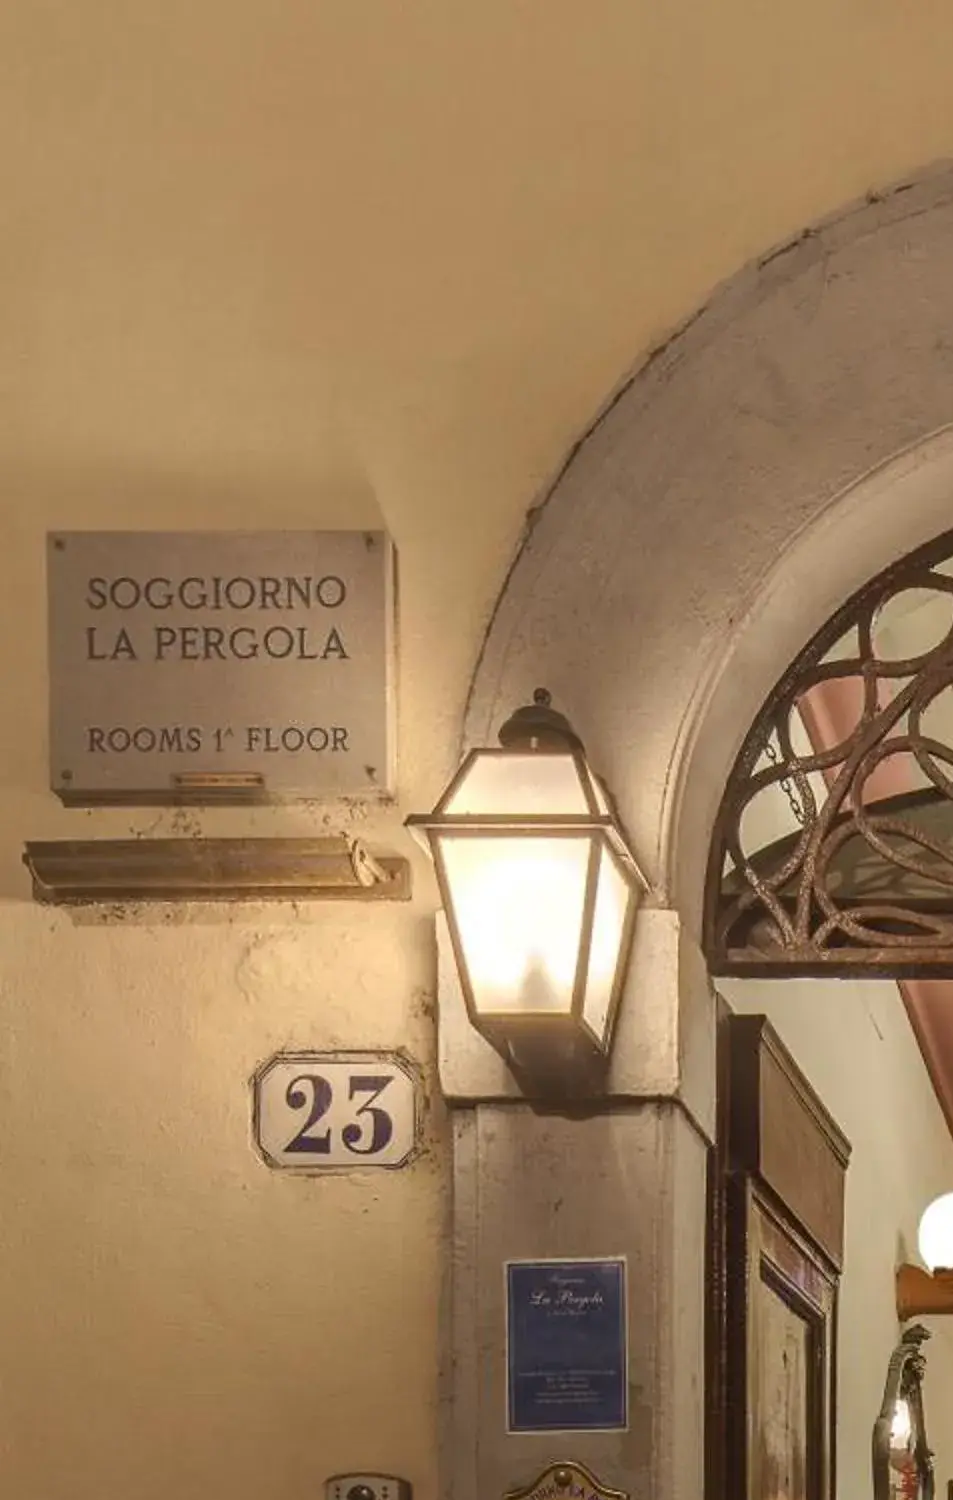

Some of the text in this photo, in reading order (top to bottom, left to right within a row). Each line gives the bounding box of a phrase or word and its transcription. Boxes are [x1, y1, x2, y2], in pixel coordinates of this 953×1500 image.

[87, 576, 347, 610] SOGGIORNO
[86, 626, 350, 661] LA PERGOLA
[88, 727, 202, 752] ROOMS
[248, 727, 350, 752] FLOOR
[283, 1074, 394, 1154] 23
